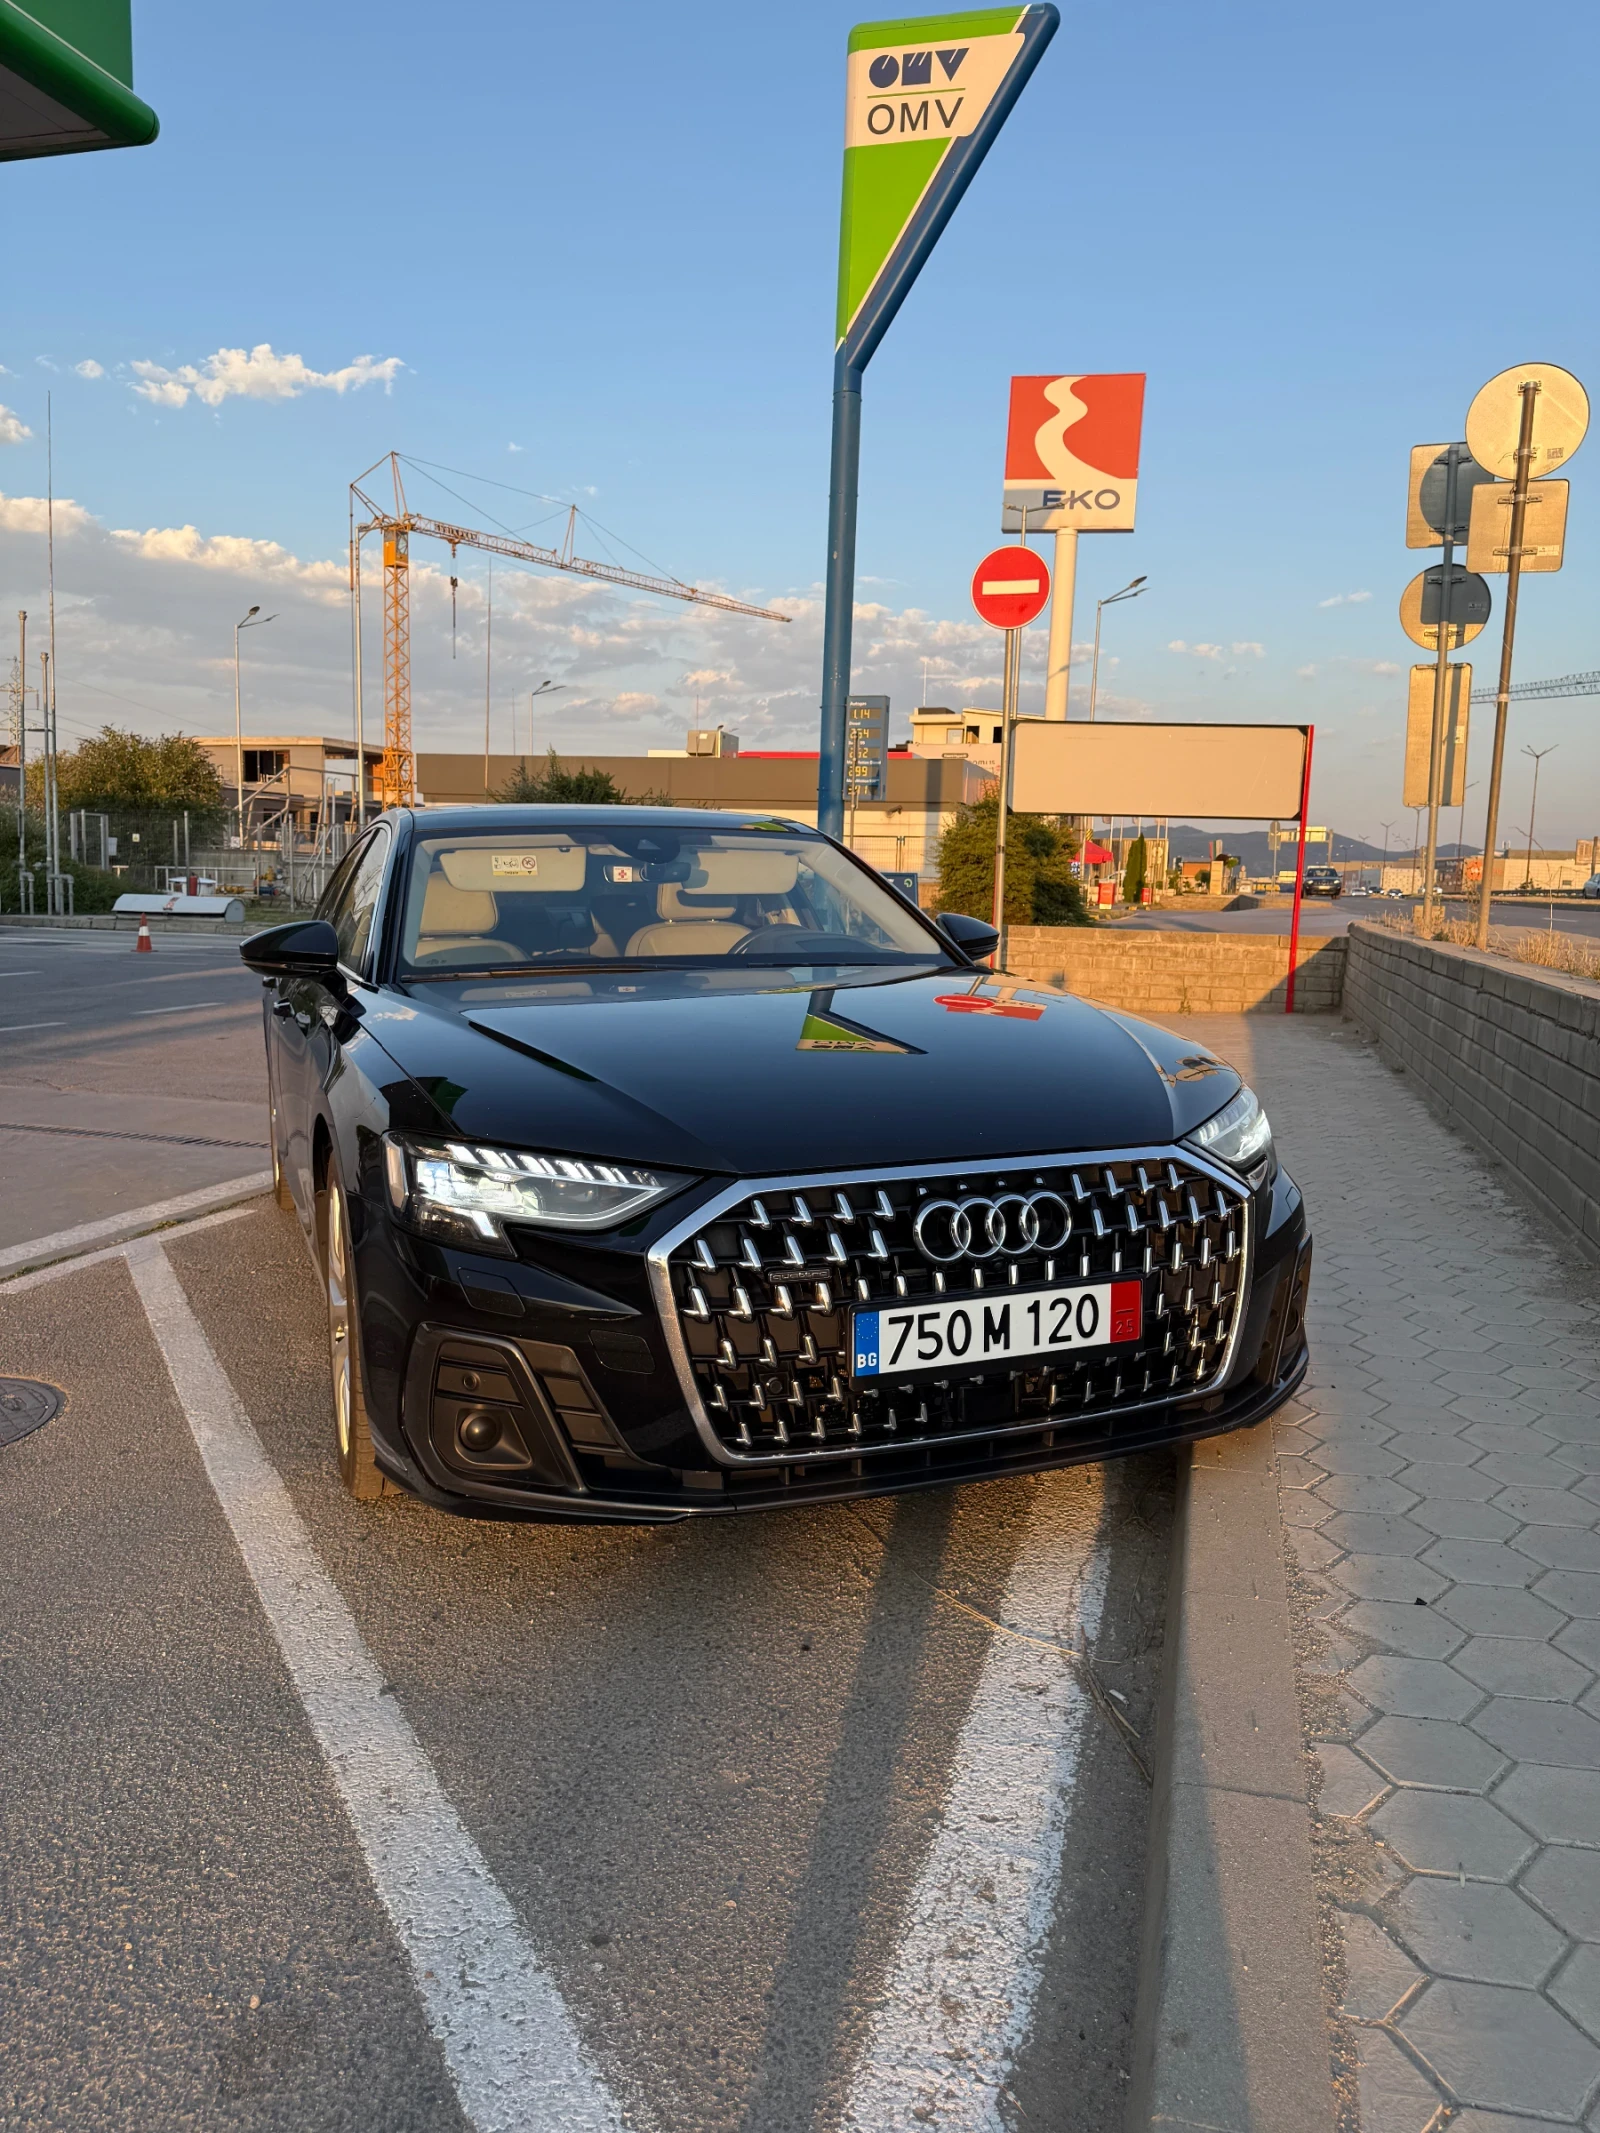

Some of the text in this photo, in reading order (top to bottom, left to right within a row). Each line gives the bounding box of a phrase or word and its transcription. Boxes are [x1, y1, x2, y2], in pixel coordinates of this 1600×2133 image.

[868, 47, 970, 89] OMV
[867, 97, 964, 135] OMV
[1043, 489, 1120, 510] EKO
[887, 1293, 1100, 1366] 750 M 120
[1115, 1319, 1134, 1336] 25
[857, 1352, 878, 1369] BG
